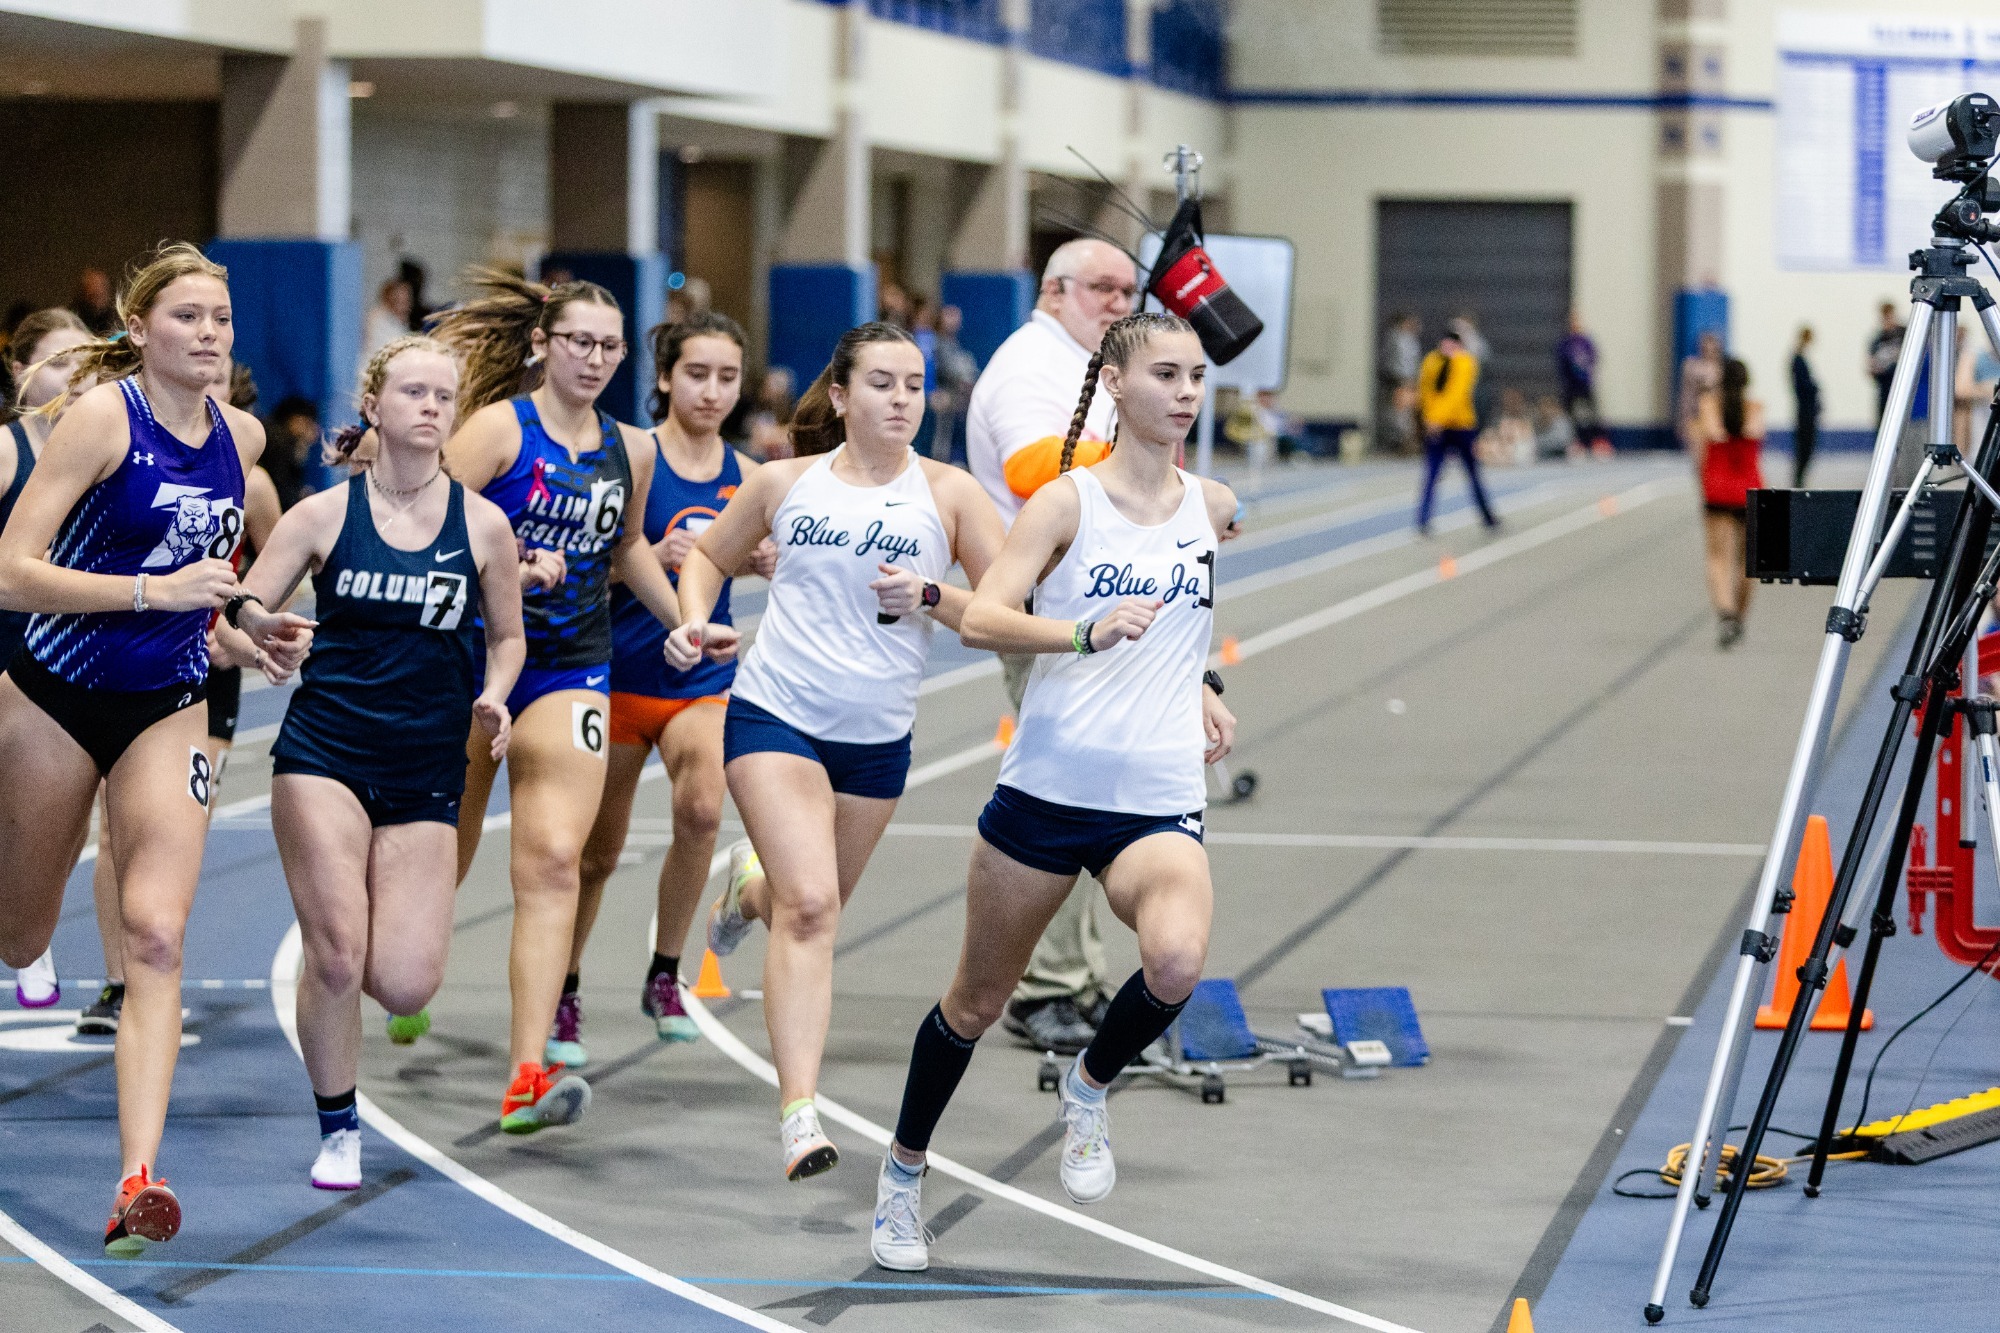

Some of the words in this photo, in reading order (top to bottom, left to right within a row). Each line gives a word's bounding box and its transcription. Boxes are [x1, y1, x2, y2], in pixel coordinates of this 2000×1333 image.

[526, 489, 589, 522] ILLIN
[594, 484, 621, 533] 6
[208, 507, 241, 560] 8
[786, 515, 851, 547] Blue
[855, 519, 922, 564] Jays
[335, 567, 428, 604] COLUM
[428, 576, 463, 627] 7
[1083, 562, 1159, 599] Blue
[1162, 562, 1200, 610] Ja
[1195, 549, 1216, 610] 1
[581, 701, 603, 753] 6
[190, 751, 210, 807] 8
